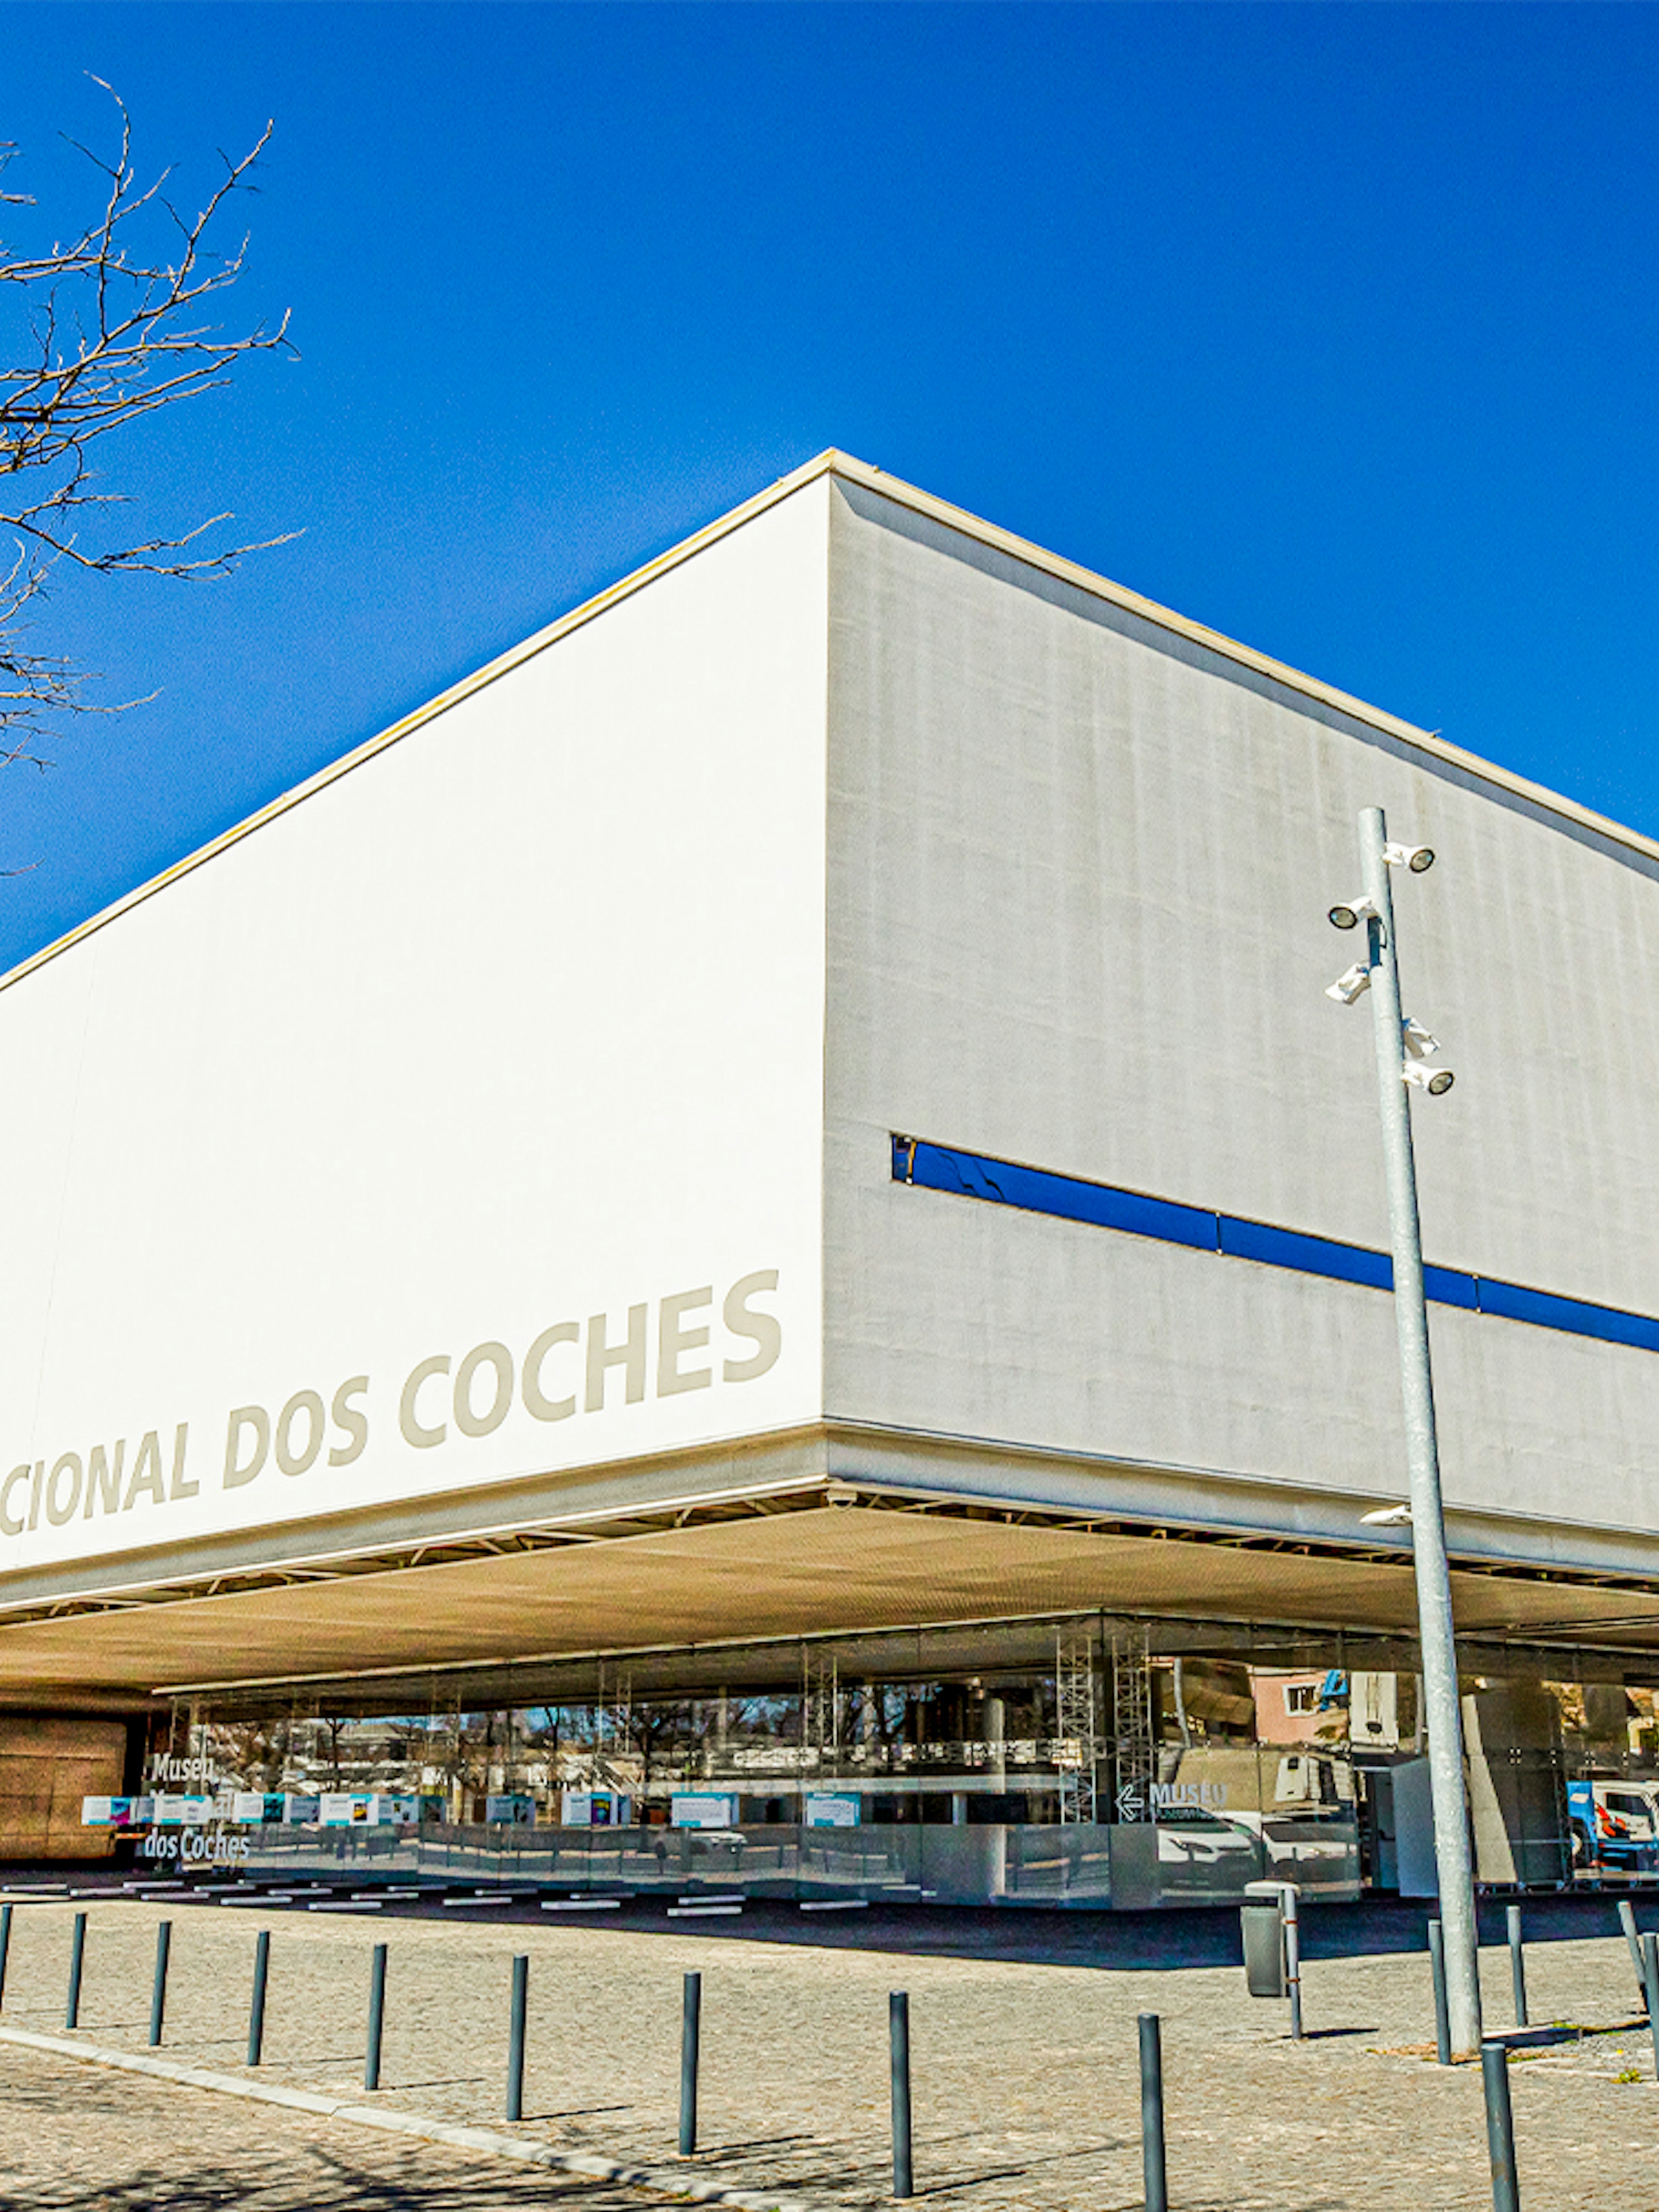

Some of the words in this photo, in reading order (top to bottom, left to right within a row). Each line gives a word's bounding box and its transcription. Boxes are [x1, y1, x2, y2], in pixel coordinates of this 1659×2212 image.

[0, 1422, 199, 1536] CIONAL
[223, 1375, 370, 1489] DOS
[399, 1269, 782, 1449] COCHES
[152, 1752, 213, 1782] Museu
[1149, 1783, 1227, 1805] MUSEU
[144, 1826, 178, 1859] dos
[180, 1827, 250, 1859] Coches
